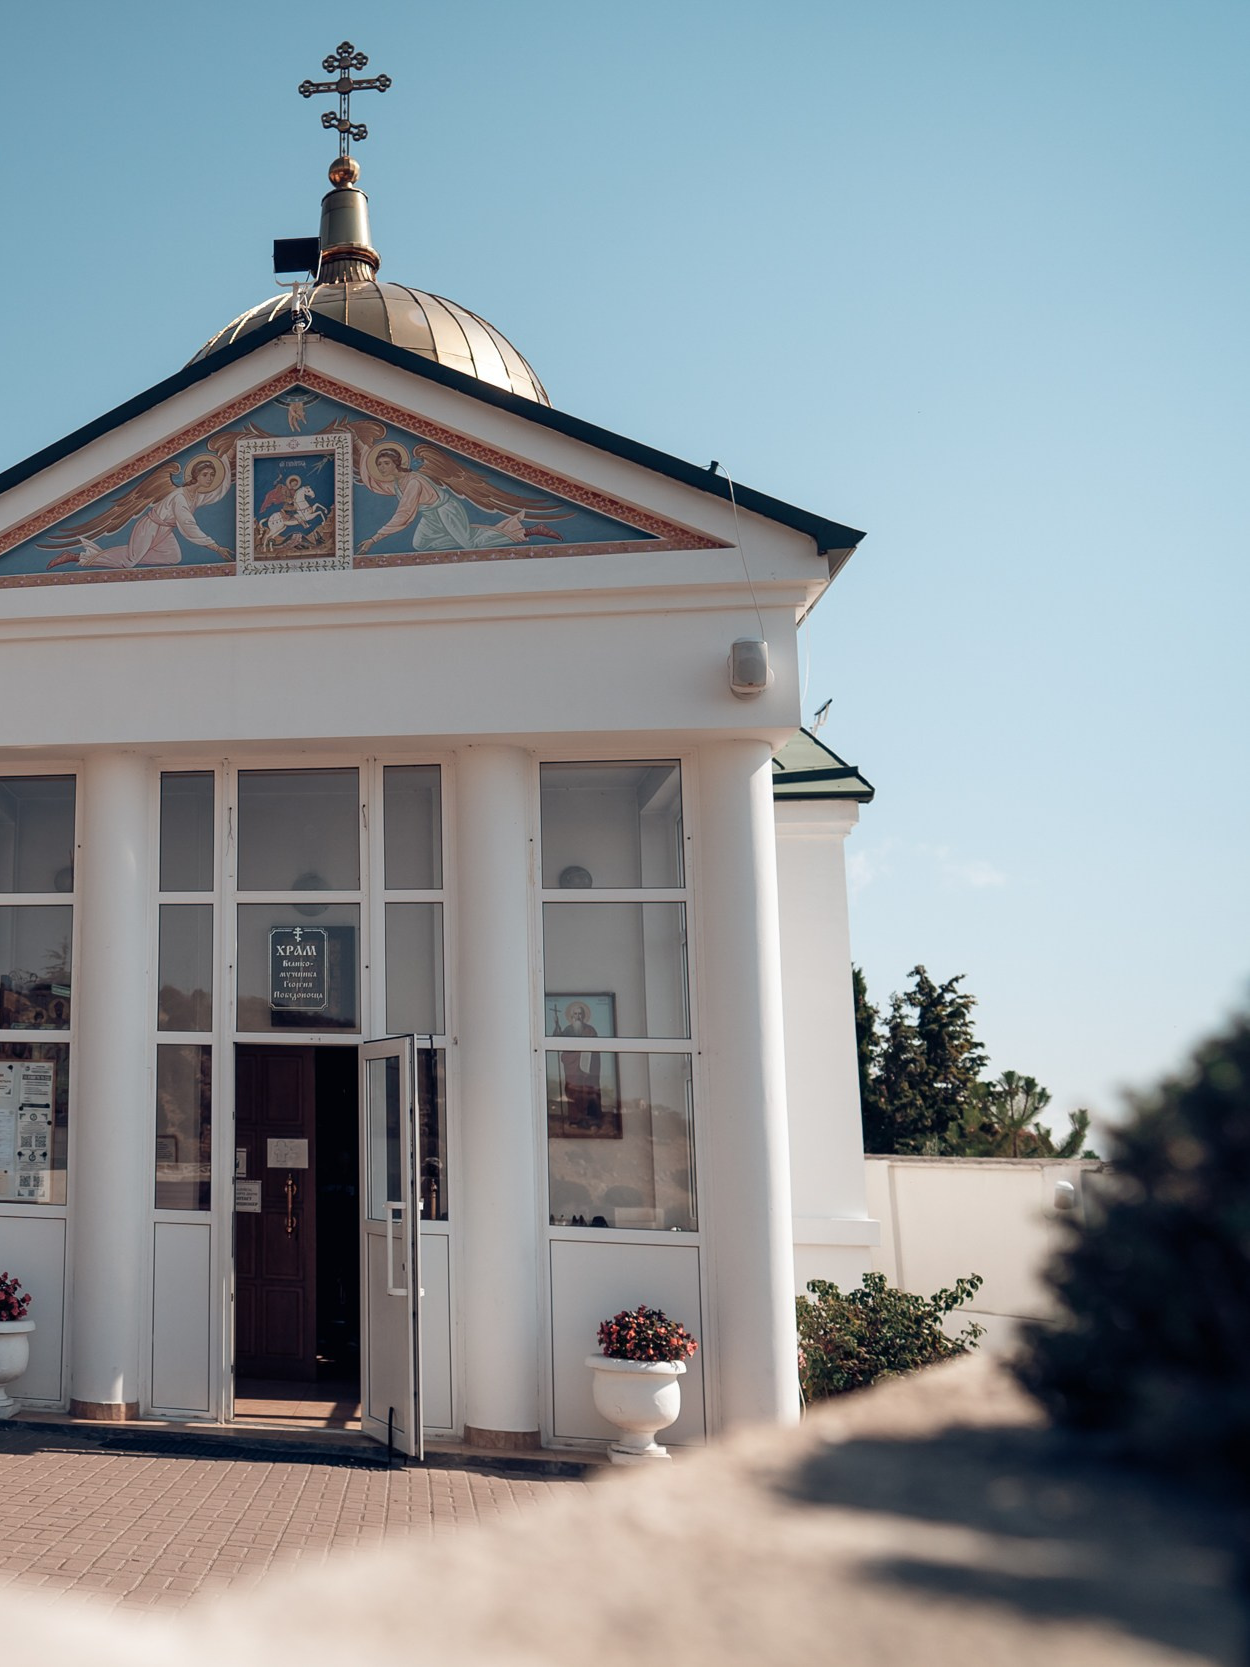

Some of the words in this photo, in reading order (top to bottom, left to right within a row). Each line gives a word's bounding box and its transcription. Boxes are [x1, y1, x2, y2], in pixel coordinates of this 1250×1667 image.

[276, 945, 317, 956] ХРАМ
[279, 971, 317, 980] мученика
[283, 980, 313, 991] Георгия
